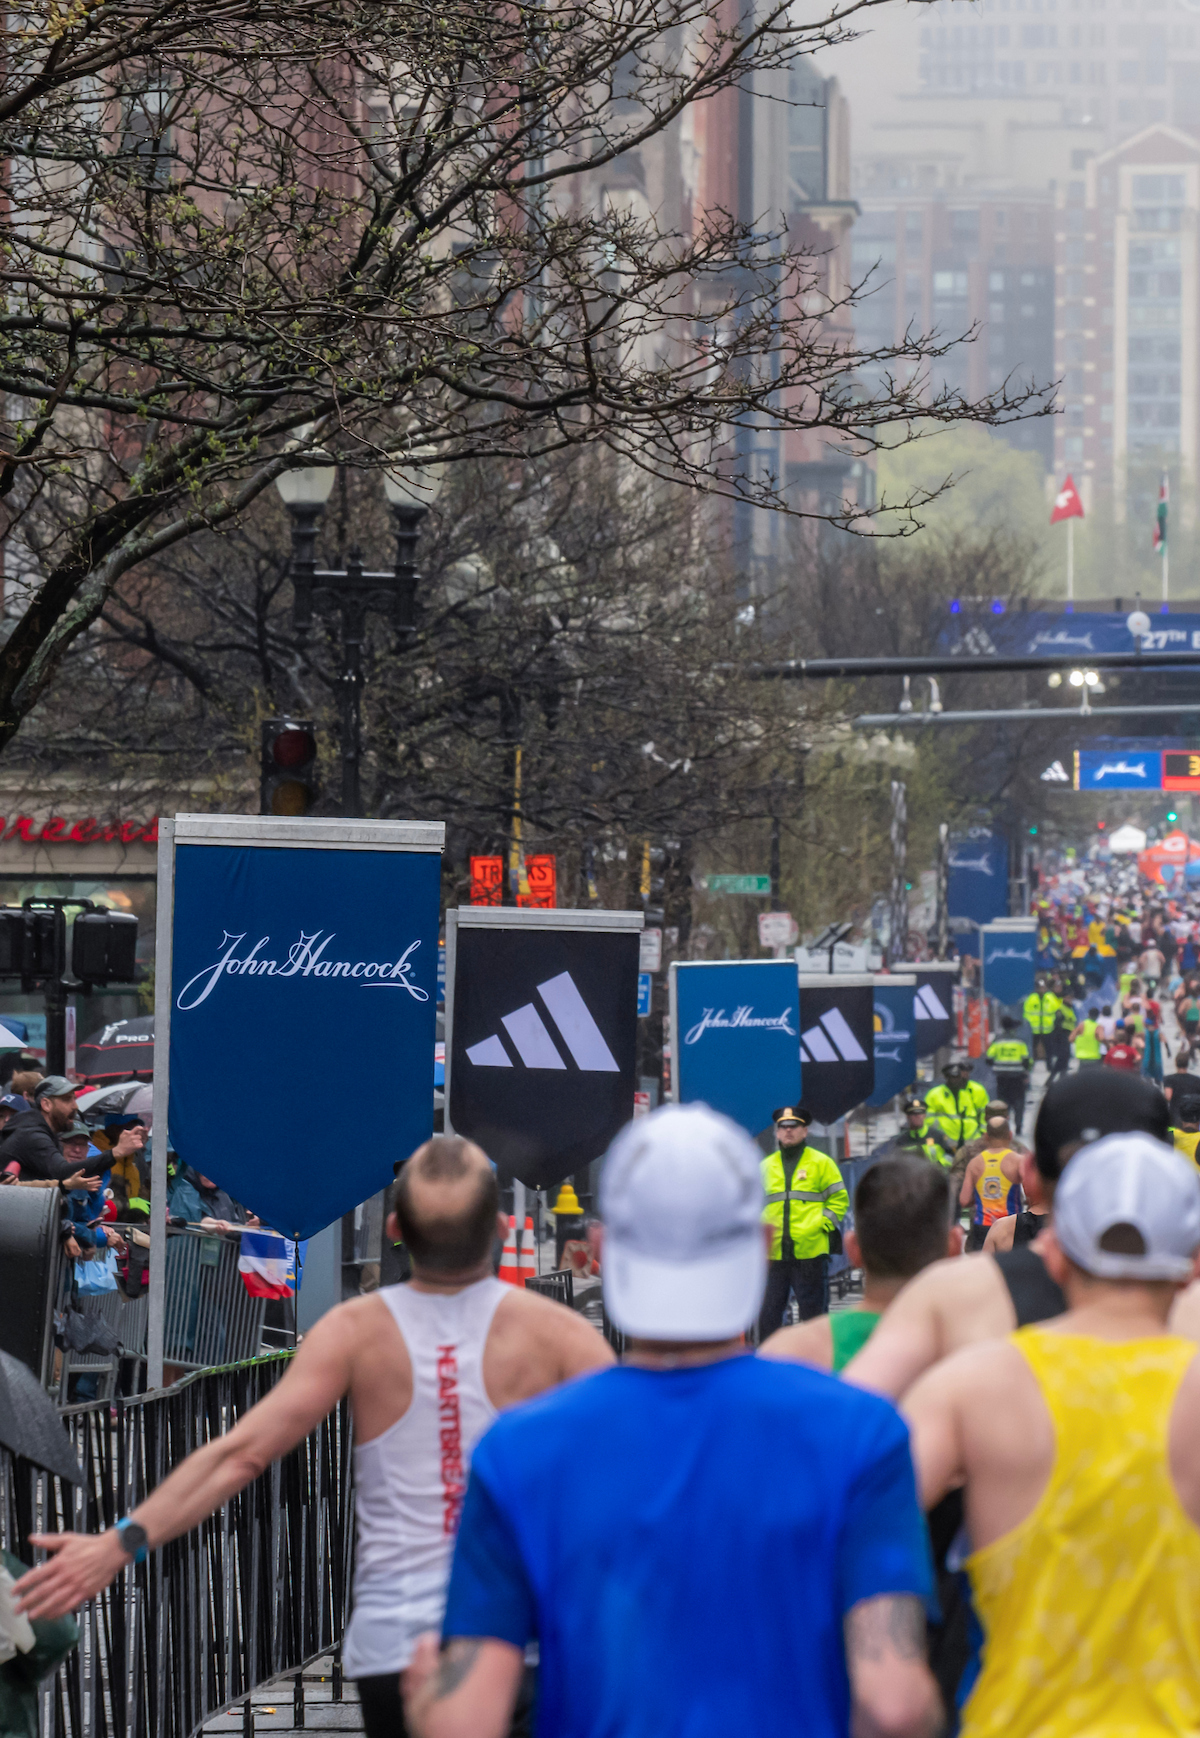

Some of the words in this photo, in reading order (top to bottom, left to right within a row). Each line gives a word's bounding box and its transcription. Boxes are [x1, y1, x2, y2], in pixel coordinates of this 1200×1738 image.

[1141, 630, 1187, 650] 27TH
[0, 815, 158, 842] reens
[176, 929, 275, 1011] John
[275, 929, 430, 1002] Hancock
[115, 1034, 149, 1043] PRO
[684, 1007, 729, 1045] John
[729, 1004, 797, 1036] Hancock
[284, 1239, 297, 1270] OSTON
